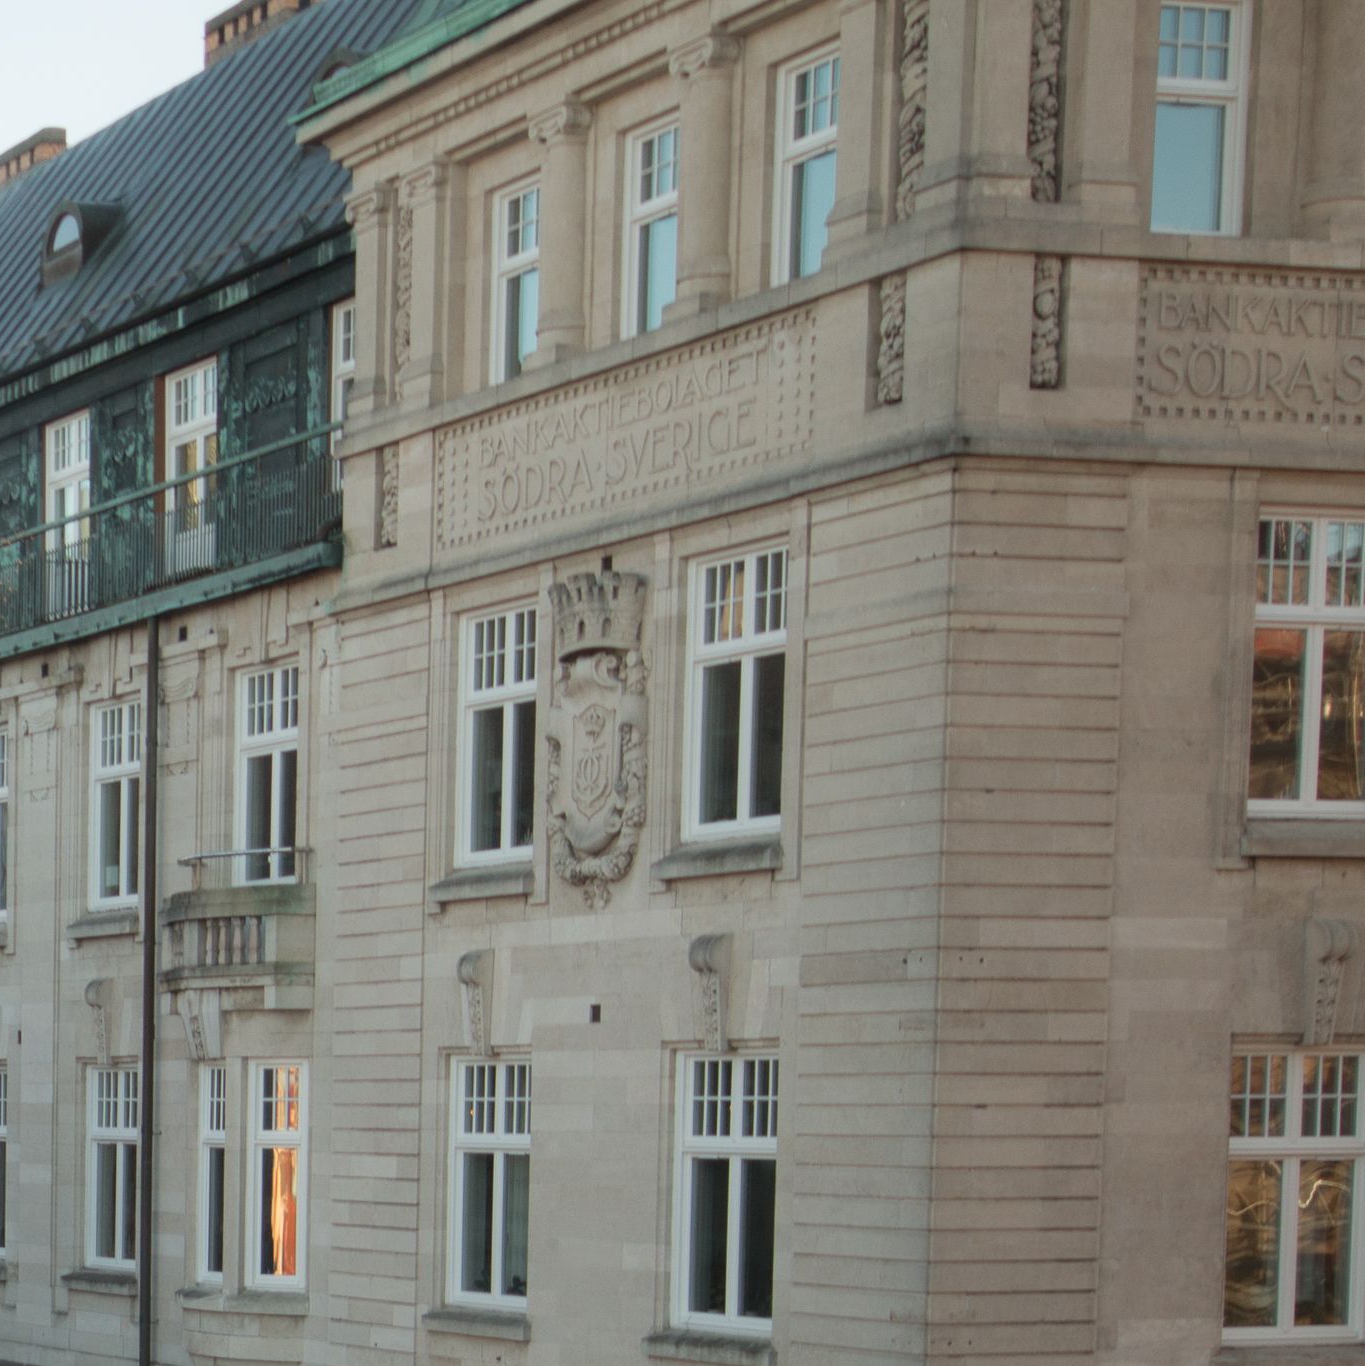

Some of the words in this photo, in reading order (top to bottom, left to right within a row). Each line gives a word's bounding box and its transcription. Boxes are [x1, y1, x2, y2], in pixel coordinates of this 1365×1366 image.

[479, 344, 771, 470] BANKAKTIEBOLAGET
[1148, 337, 1324, 413] SÖDRA
[477, 449, 593, 523] SÖDRA
[605, 397, 757, 487] SVERIGE
